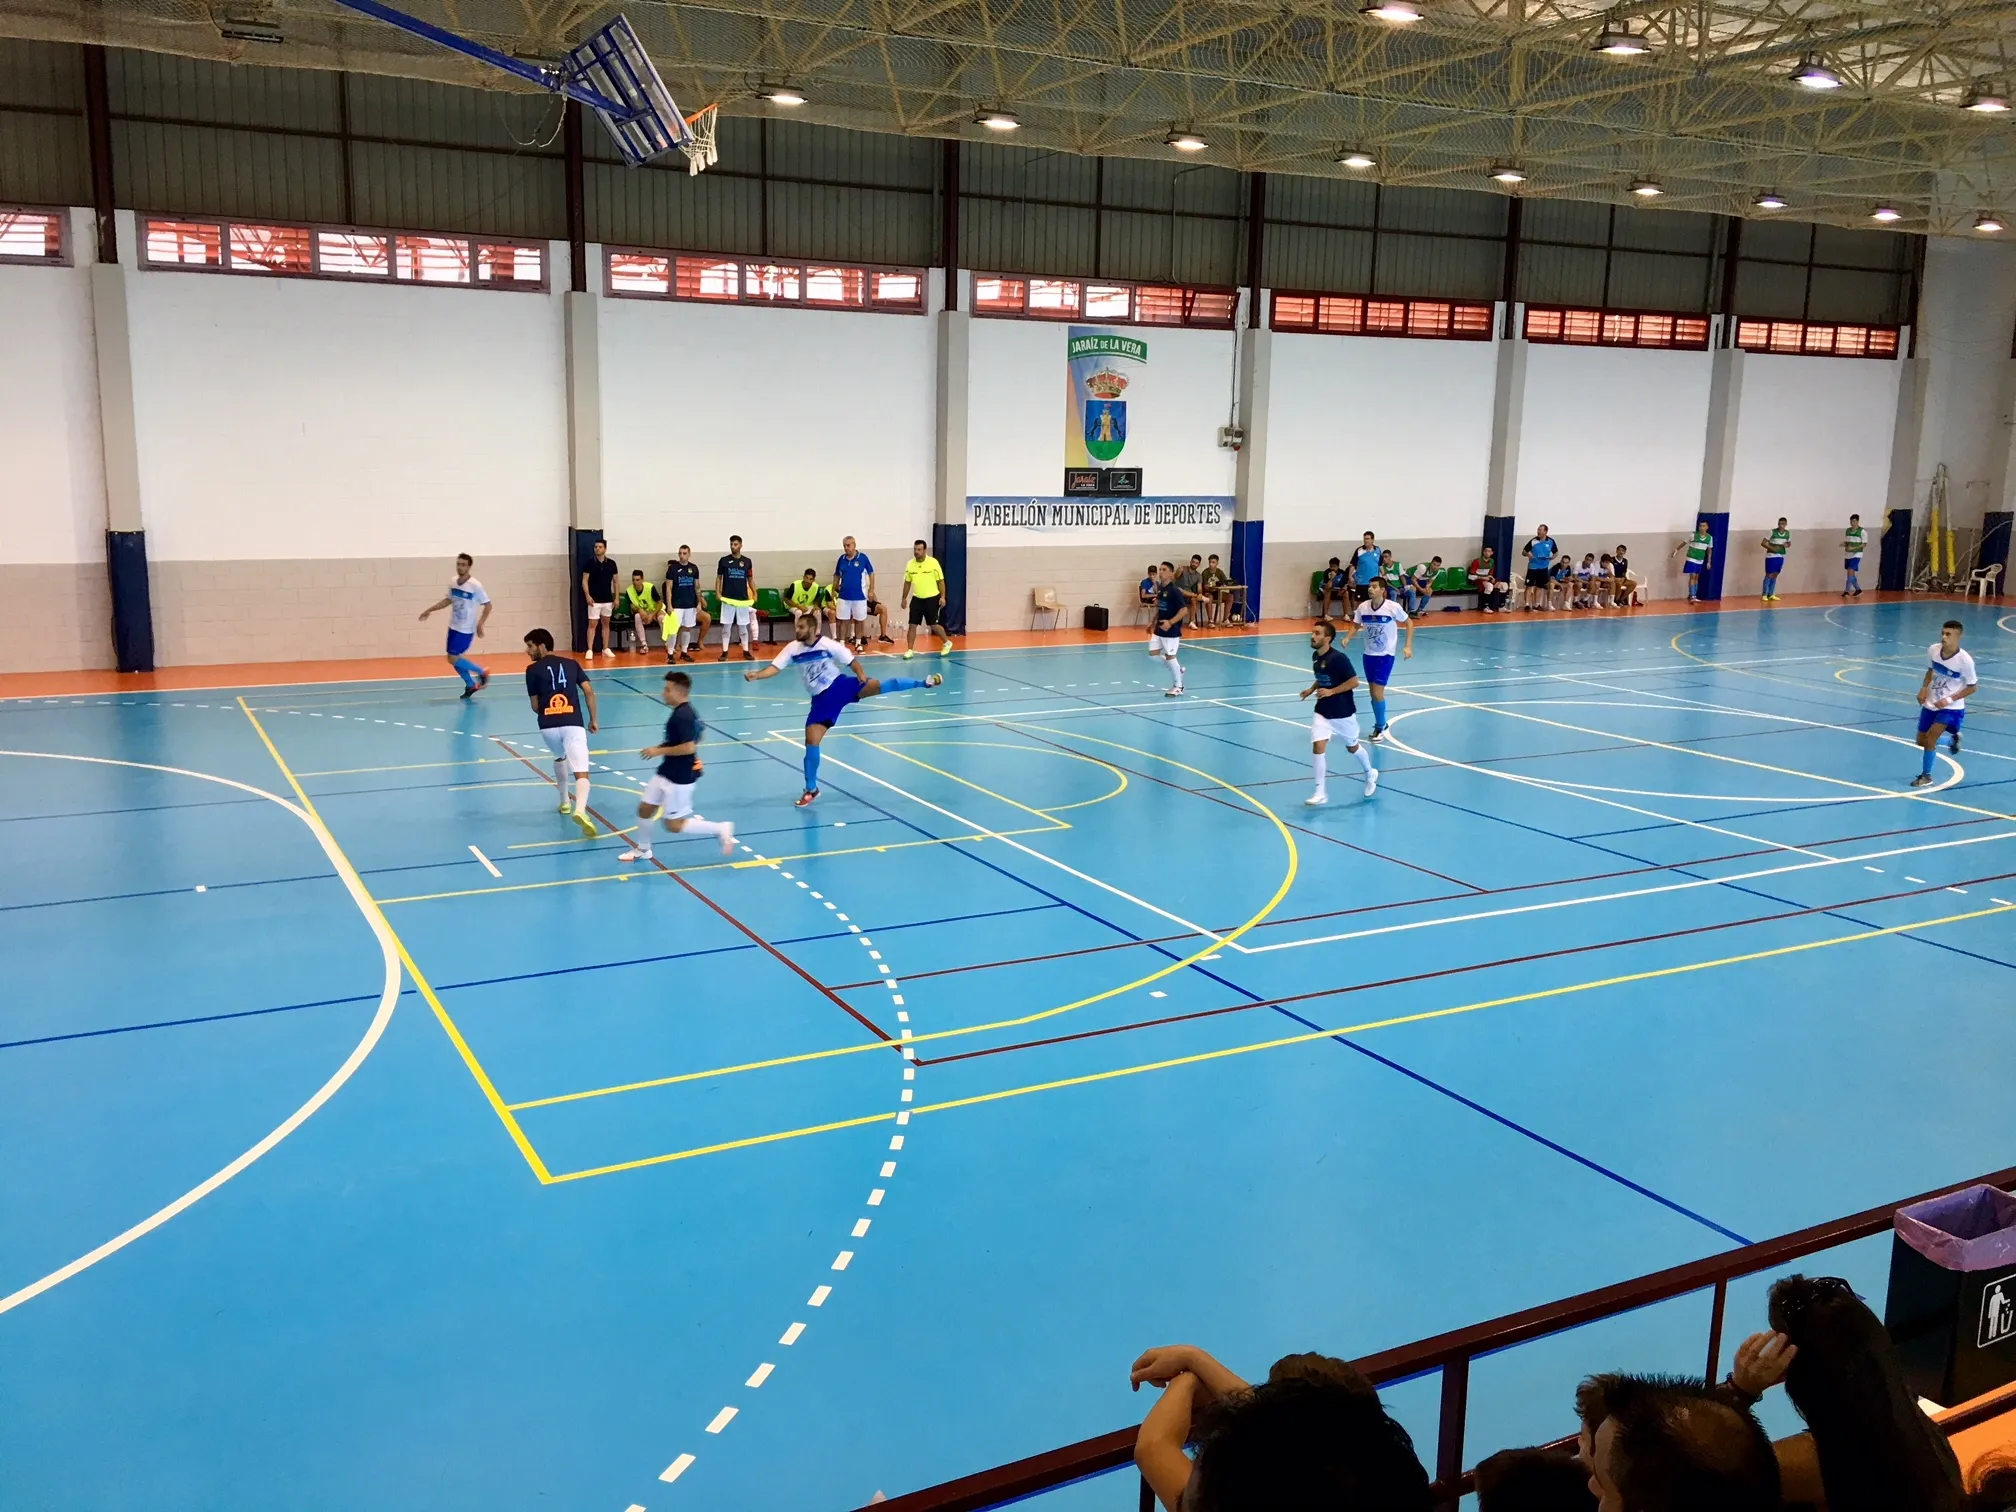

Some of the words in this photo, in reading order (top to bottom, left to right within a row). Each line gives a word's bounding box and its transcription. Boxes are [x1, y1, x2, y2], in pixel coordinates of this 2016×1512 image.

[1072, 337, 1098, 353] JARAÍZ
[1100, 340, 1108, 349] DE
[1110, 339, 1119, 350] LA
[1121, 340, 1141, 356] VERA
[973, 499, 1047, 526] PABELLÓN
[1052, 504, 1130, 526] MUNICIPAL
[1133, 504, 1151, 525] DE
[1154, 503, 1221, 524] DEPORTES
[547, 663, 567, 690] 14
